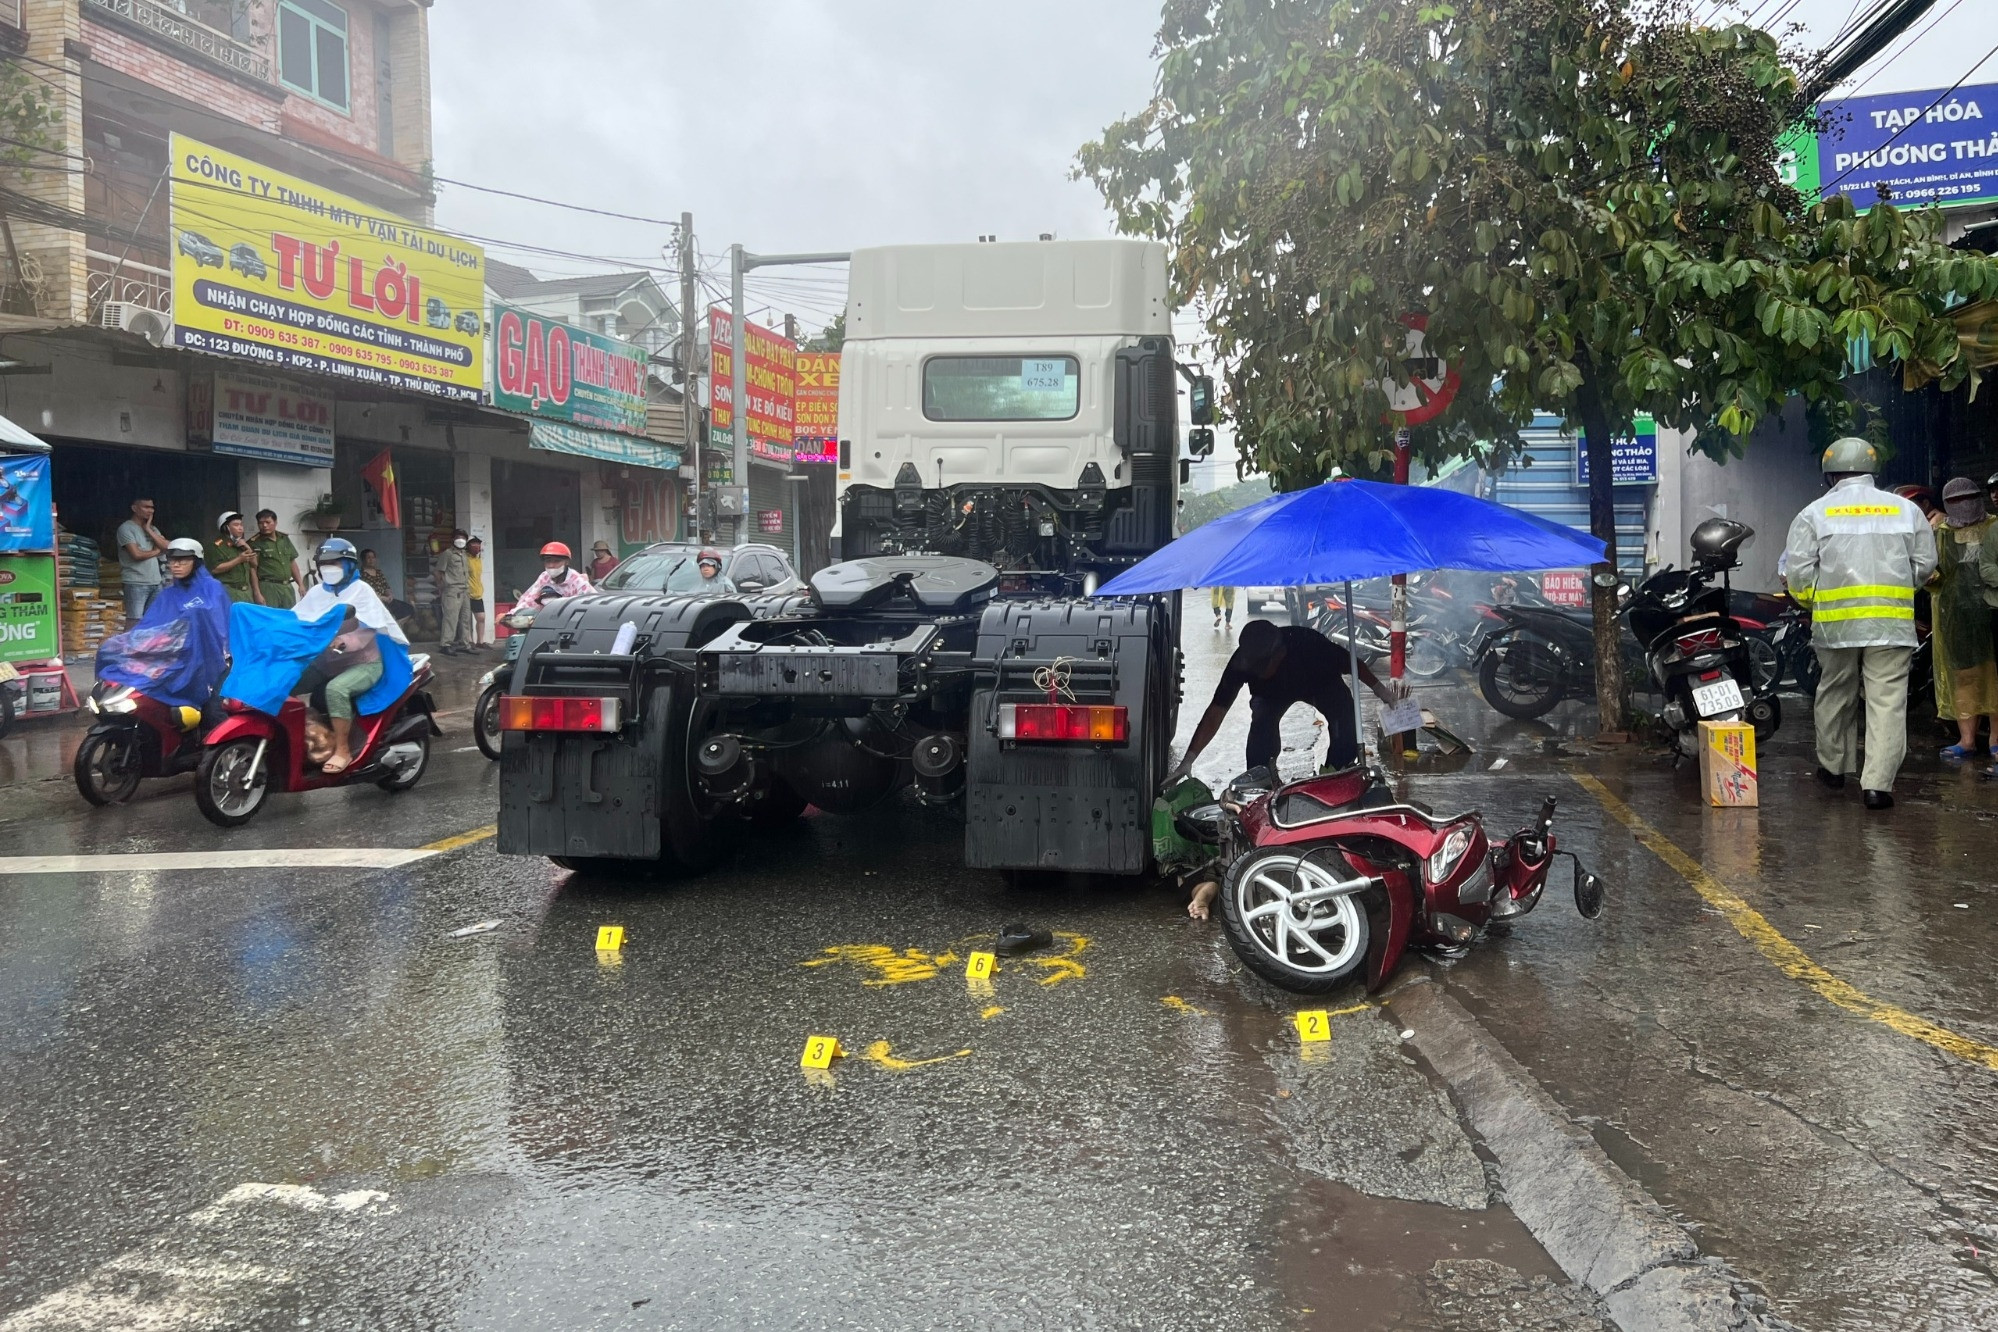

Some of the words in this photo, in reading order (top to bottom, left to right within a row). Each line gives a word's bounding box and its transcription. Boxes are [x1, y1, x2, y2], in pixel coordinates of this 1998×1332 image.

[1870, 107, 1920, 133] TẠP
[1925, 98, 1983, 124] HÓA
[1835, 143, 1947, 172] PHƯƠNG
[1950, 131, 1998, 160] THẢ
[1839, 183, 1860, 191] 15/22
[1860, 181, 1870, 189] LÊ
[1889, 177, 1913, 186] TÁCH,
[1914, 176, 1925, 184] AN
[1926, 174, 1948, 183] BÌNH,
[1959, 171, 1973, 180] AN,
[1973, 169, 1993, 178] BÌNH
[1906, 188, 1936, 199] 0966
[1937, 186, 1959, 196] 226
[1961, 184, 1981, 193] 195
[186, 154, 242, 188] CÔNG
[248, 175, 271, 197] TY
[277, 186, 324, 217] TNHH
[330, 205, 362, 229] MTV
[401, 229, 422, 251] TẢI
[428, 239, 445, 258] DU
[450, 247, 477, 269] LỊCH
[271, 231, 340, 299] TƯ
[348, 255, 420, 325] LỜI
[207, 288, 246, 310] NHẬN
[250, 299, 285, 320] CHẠY
[289, 309, 314, 327] HỢP
[317, 314, 350, 335] ĐỒNG
[352, 324, 375, 341] CÁC
[377, 328, 401, 347] TỈNH
[410, 339, 442, 358] THÀNH
[445, 347, 464, 361] PHỐ
[224, 318, 244, 333] ĐT:
[248, 324, 275, 340] 0909
[278, 331, 298, 344] 635
[301, 336, 320, 349] 387
[329, 343, 353, 356] 0909
[356, 349, 372, 361] 635
[376, 353, 391, 365] 795
[399, 359, 420, 372] 0903
[422, 363, 437, 375] 635
[439, 368, 454, 378] 387
[184, 332, 206, 347] ĐC:
[209, 337, 230, 351] 123
[232, 342, 274, 361] ĐƯỜNG
[277, 352, 284, 363] 5
[292, 354, 313, 368] KP2
[320, 360, 329, 372] P.
[332, 363, 355, 377] LINH
[357, 367, 382, 383] XUÂN
[389, 375, 403, 387] TP.
[405, 377, 422, 390] THỦ
[423, 380, 441, 395] ĐỨC
[447, 387, 459, 398] TP.
[460, 389, 478, 401] HCM
[498, 311, 571, 410] GẠO
[714, 351, 731, 377] TEM
[796, 354, 840, 372] DÁN
[1034, 363, 1053, 372] T89
[608, 352, 638, 397] CHUNG
[640, 363, 647, 399] 2
[799, 372, 839, 386] XE
[1027, 378, 1059, 388] 675.28
[715, 385, 732, 404] SƠN
[225, 386, 272, 415] TƯ
[279, 396, 329, 425] LỜI
[752, 397, 763, 413] XE
[776, 400, 793, 422] KIỂU
[714, 407, 731, 426] THAY
[796, 413, 812, 424] SƠN
[795, 425, 816, 435] BỌC
[1624, 446, 1653, 456] THẢO
[1544, 574, 1560, 589] BẢO
[1563, 574, 1583, 589] HIỂM
[1568, 591, 1583, 602] MÁY
[1700, 694, 1740, 714] 735.09
[606, 931, 612, 944] 1
[975, 957, 985, 972] 6
[1308, 1016, 1320, 1034] 2
[812, 1042, 824, 1060] 3
